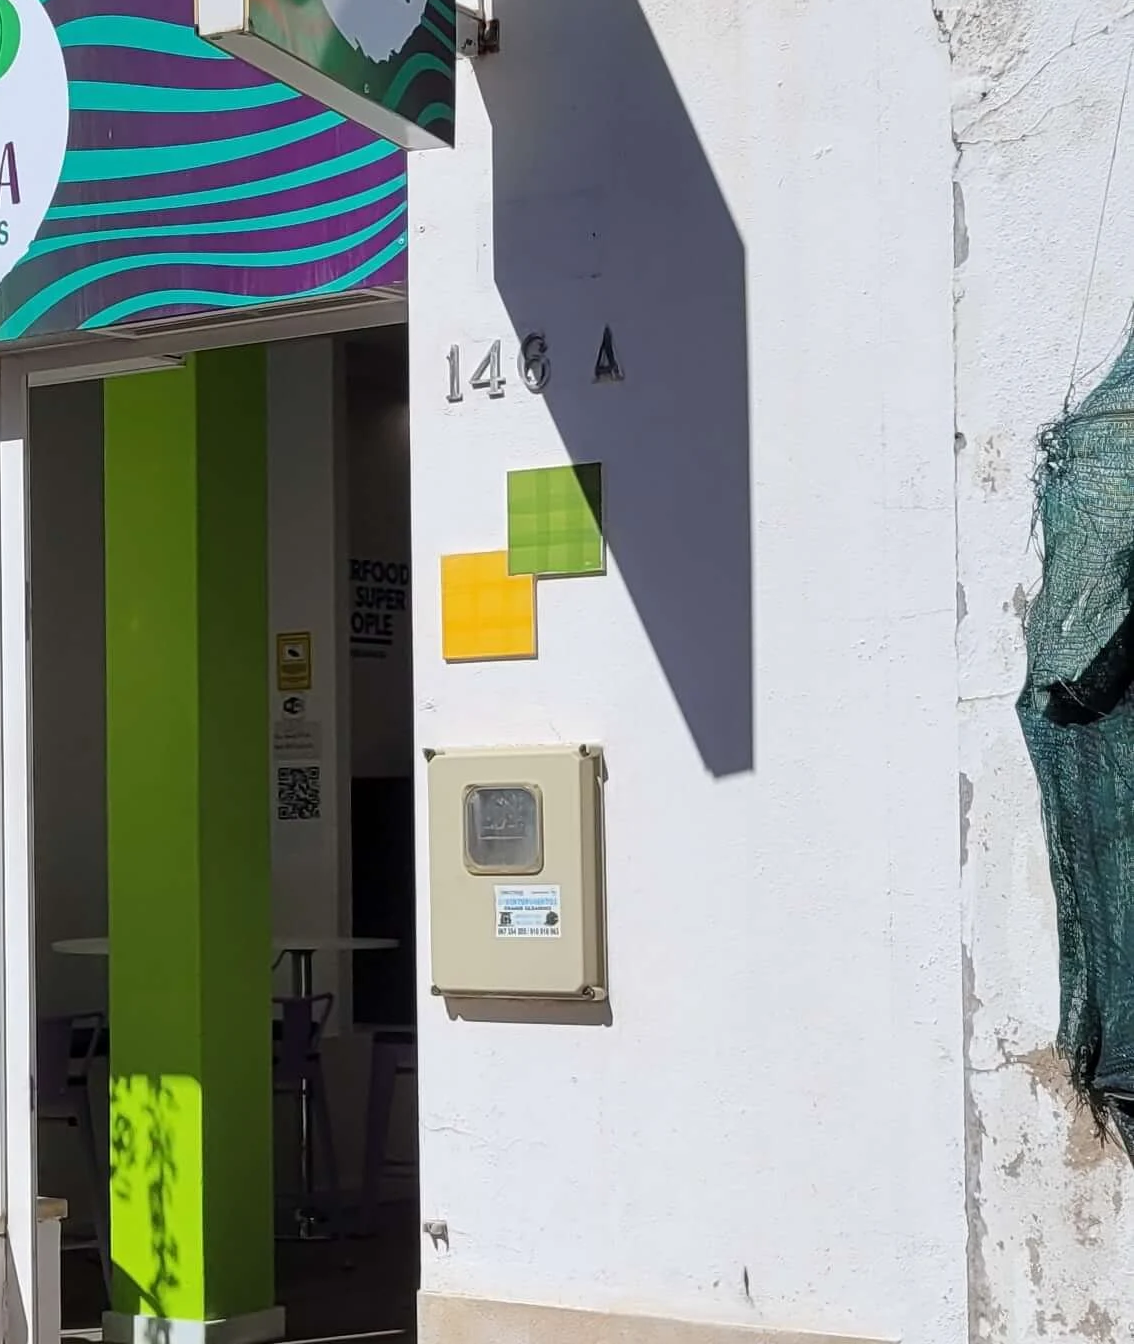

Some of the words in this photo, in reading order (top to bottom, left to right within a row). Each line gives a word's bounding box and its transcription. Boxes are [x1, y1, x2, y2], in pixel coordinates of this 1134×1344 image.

[445, 331, 552, 404] 146
[591, 323, 626, 385] A
[356, 585, 406, 610] SUPER
